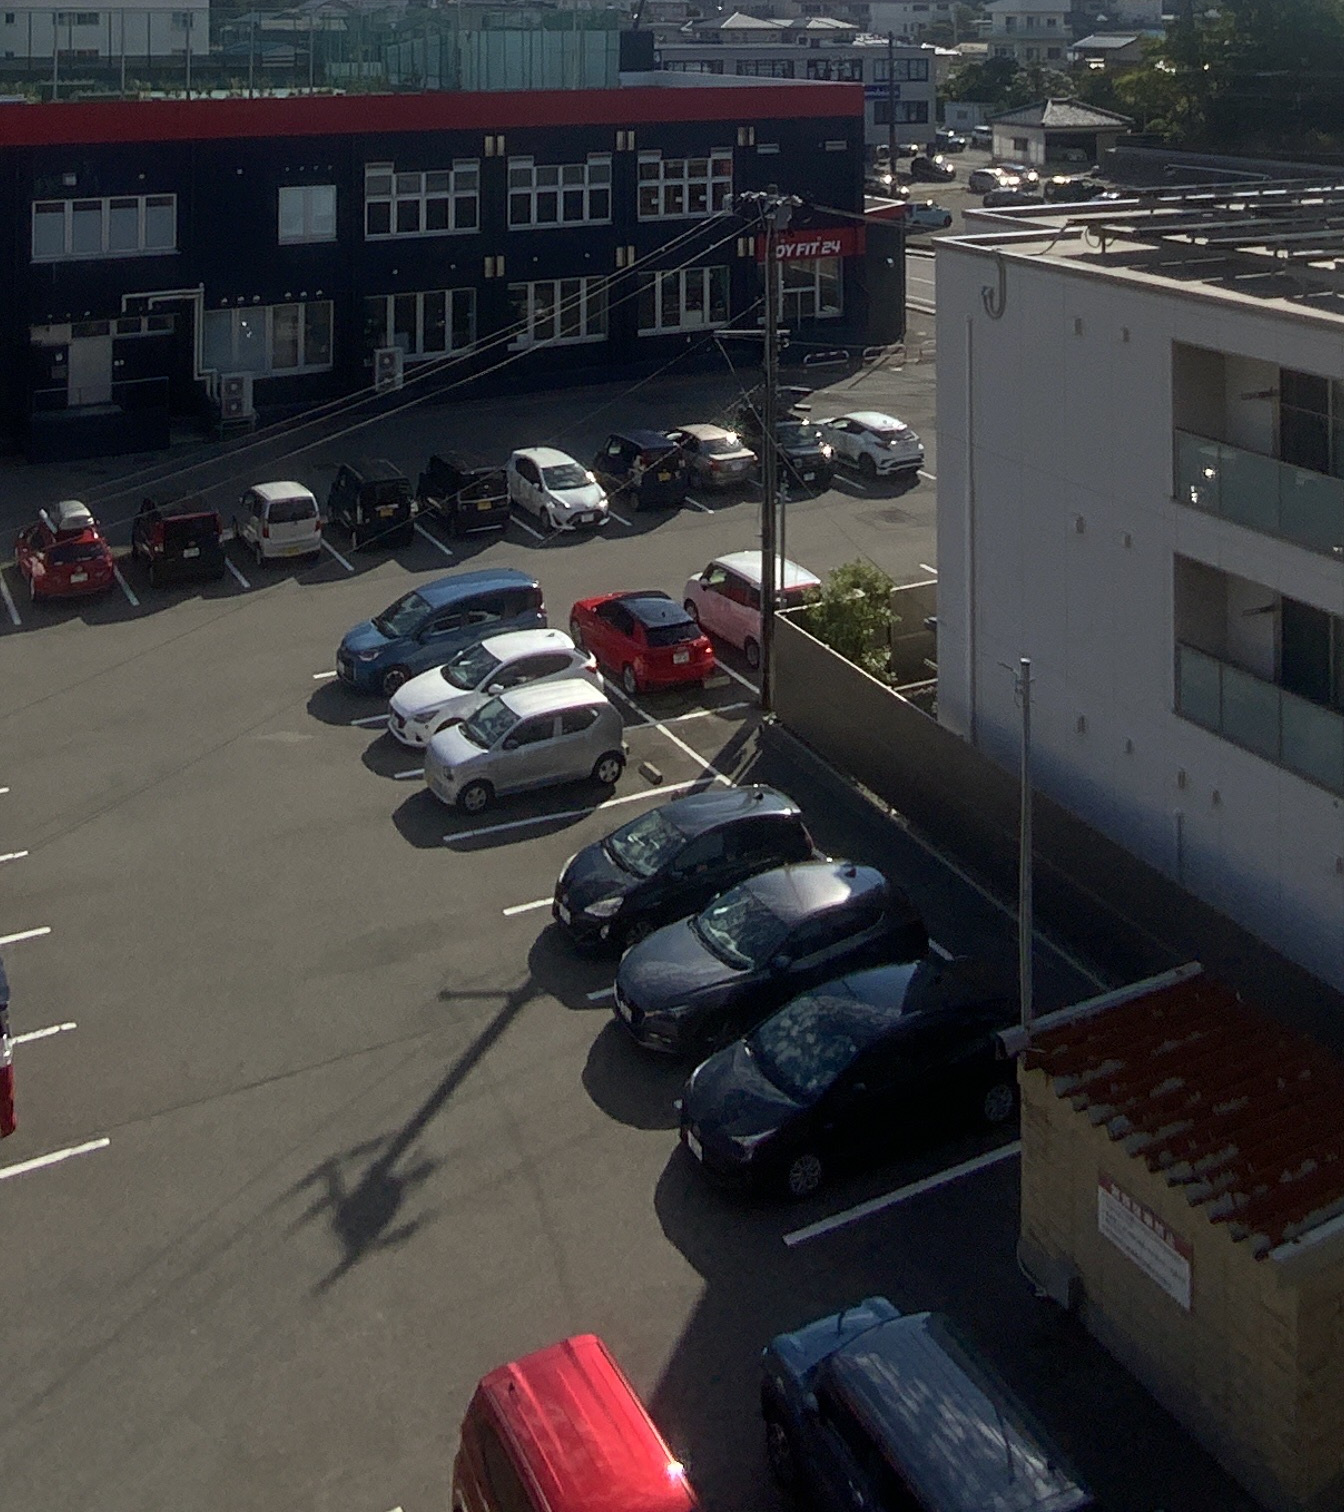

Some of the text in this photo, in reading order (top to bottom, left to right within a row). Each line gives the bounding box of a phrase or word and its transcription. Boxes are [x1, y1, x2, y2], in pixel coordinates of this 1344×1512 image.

[776, 240, 841, 258] OY FIT 24
